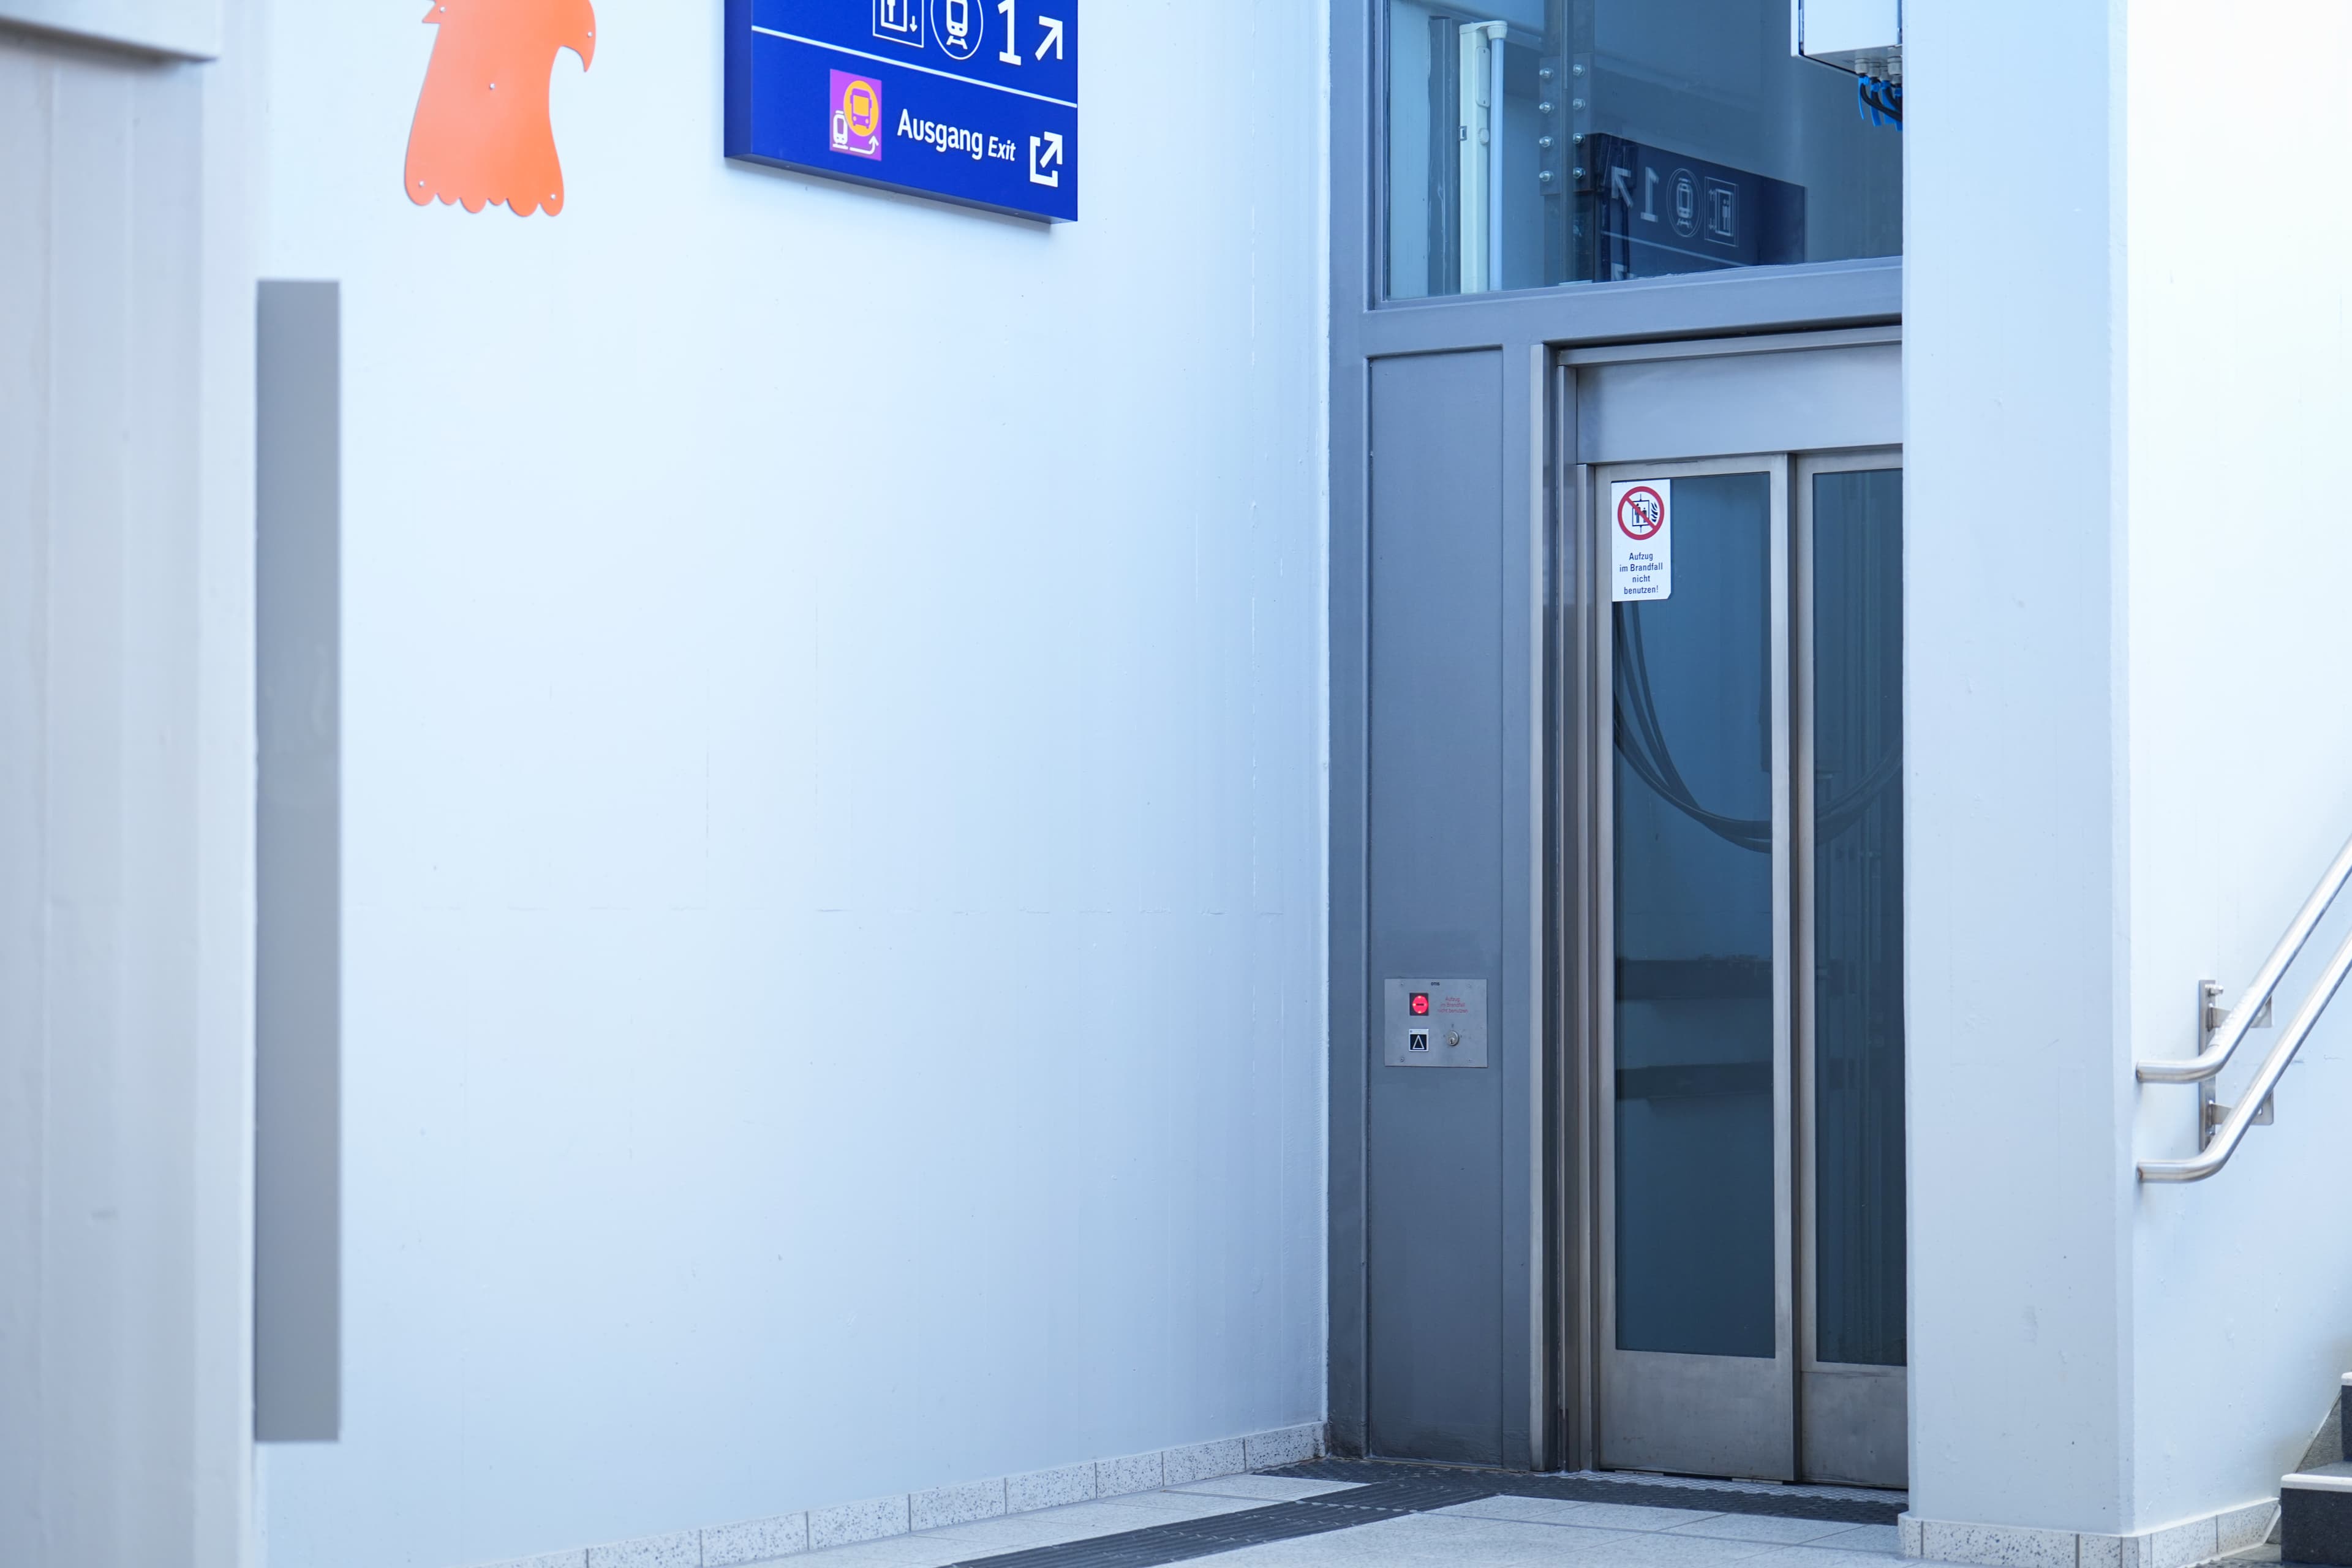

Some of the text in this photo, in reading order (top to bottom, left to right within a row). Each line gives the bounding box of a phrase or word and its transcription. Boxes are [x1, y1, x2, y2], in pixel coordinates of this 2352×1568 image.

[998, 0, 1022, 66] 1
[897, 108, 1016, 161] Ausgang Exit
[1629, 552, 1653, 561] Aufzug
[1630, 562, 1663, 571] Brandfall
[1624, 586, 1659, 595] benutzen!
